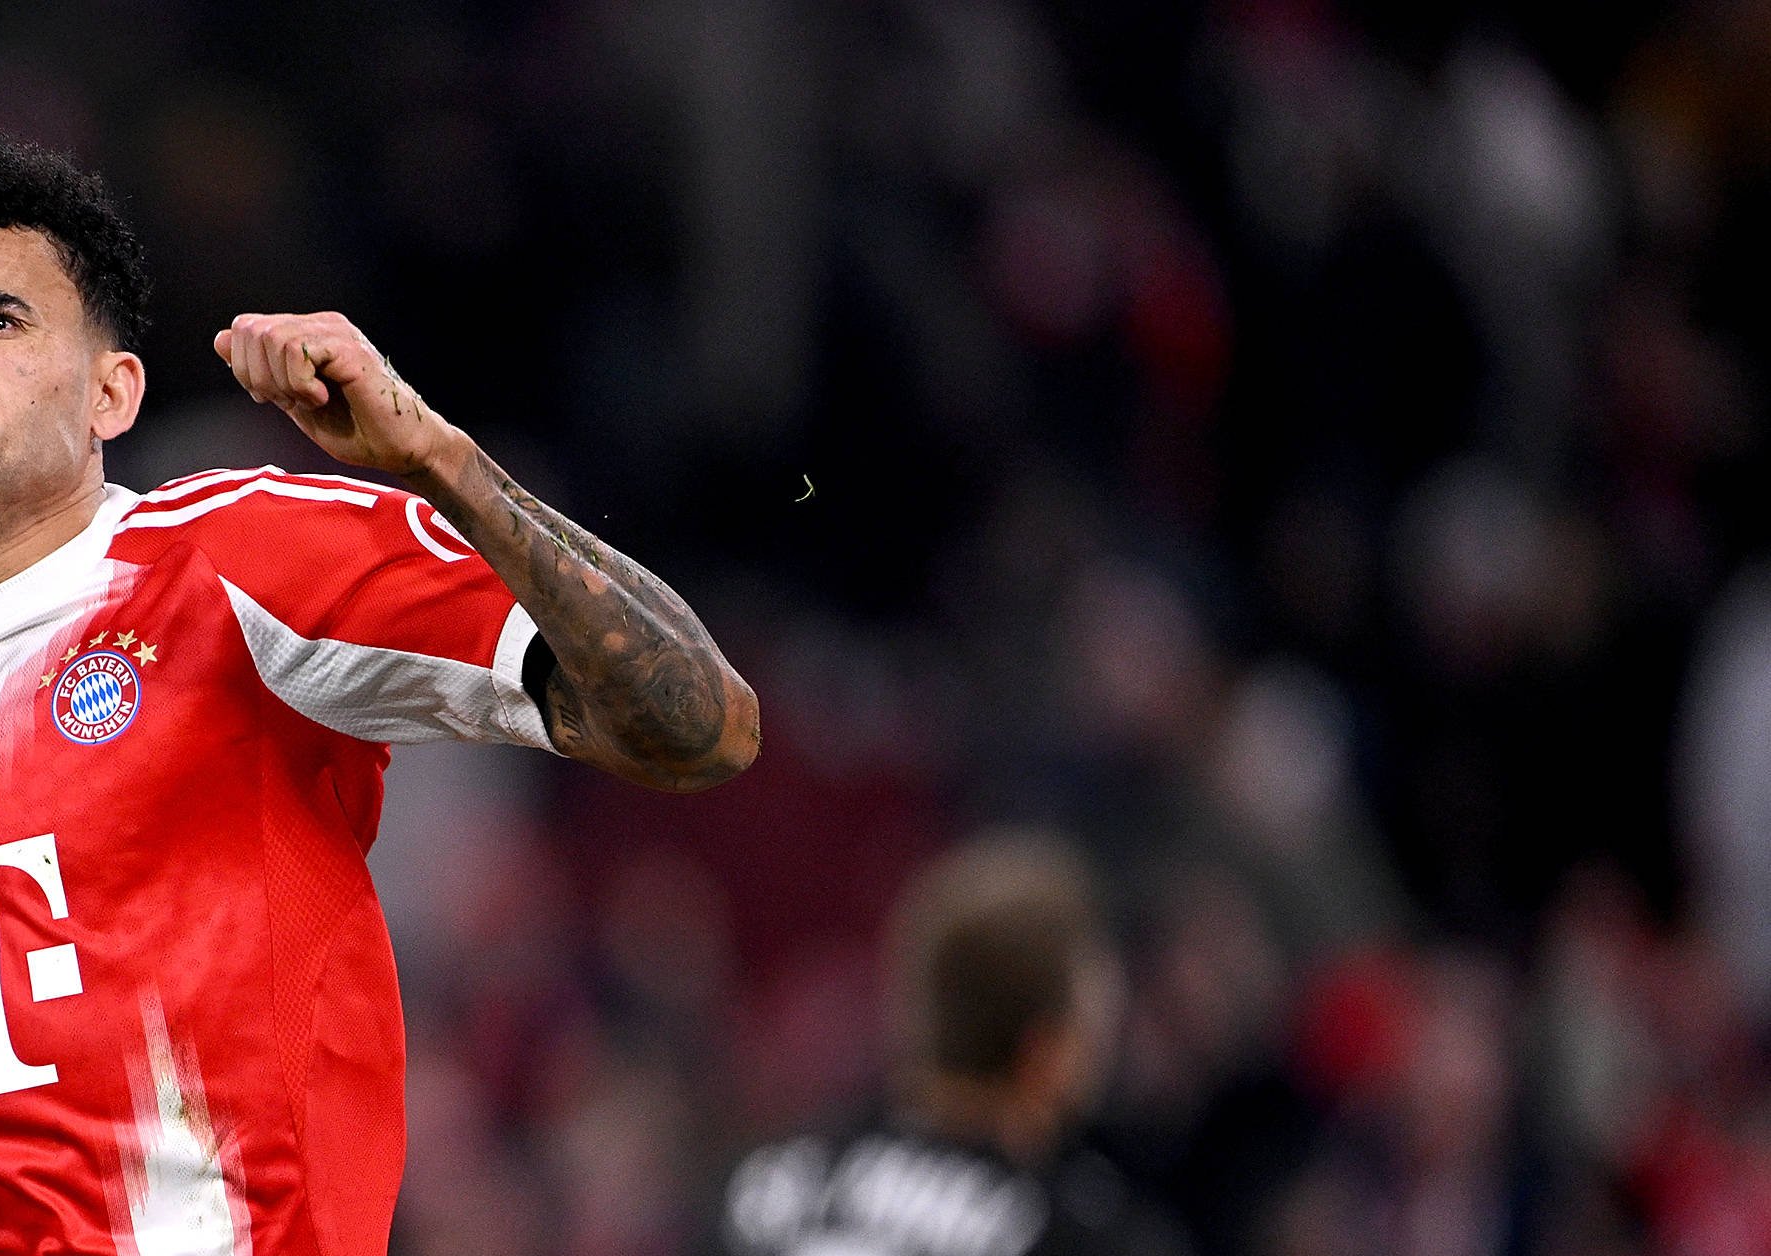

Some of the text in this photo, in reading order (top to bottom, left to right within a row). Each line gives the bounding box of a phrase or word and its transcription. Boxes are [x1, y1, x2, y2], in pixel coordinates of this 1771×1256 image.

[61, 658, 132, 698] FC BAYERN
[60, 702, 133, 738] MÜNCHEN
